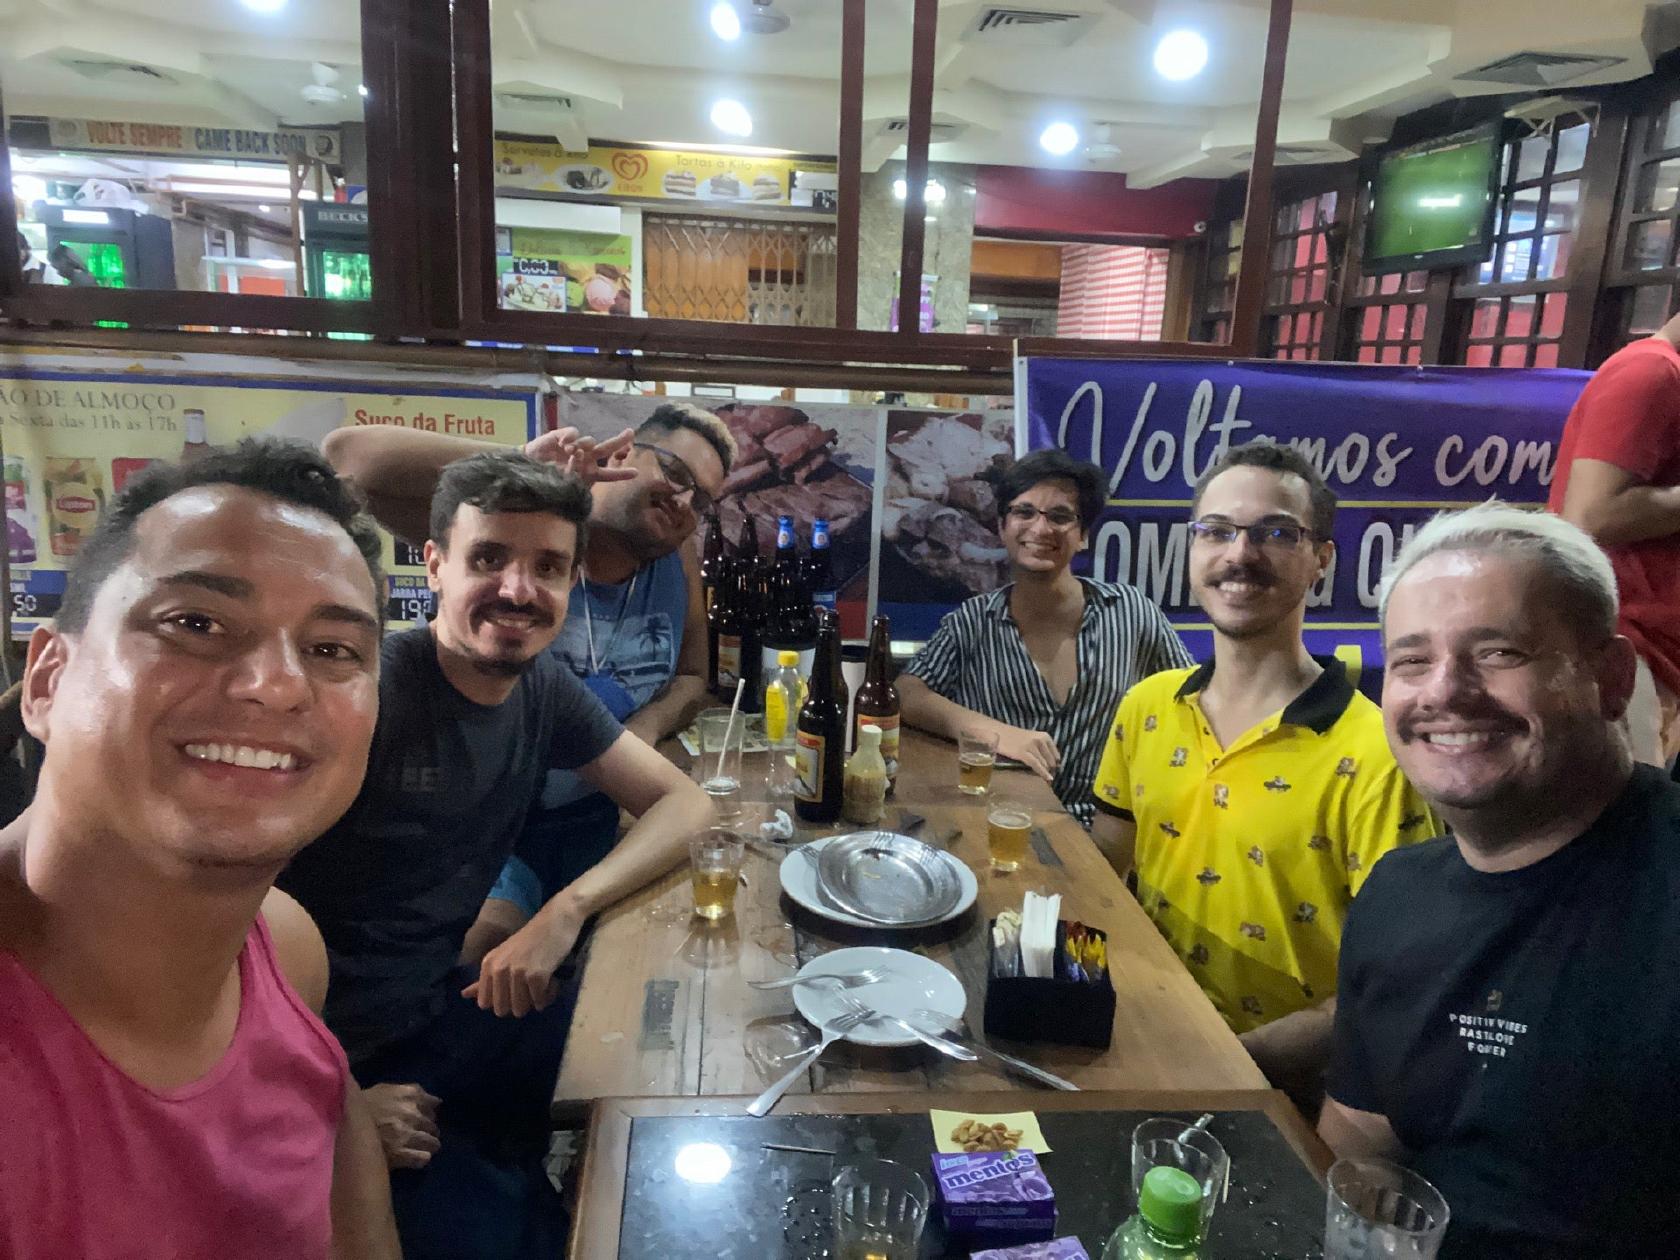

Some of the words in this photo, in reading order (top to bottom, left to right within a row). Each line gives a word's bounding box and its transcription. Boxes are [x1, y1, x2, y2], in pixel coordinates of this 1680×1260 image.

[86, 121, 127, 144] VOLTE
[129, 122, 183, 148] SEMPRE
[194, 127, 232, 151] CAME
[235, 129, 269, 153] BACK
[677, 154, 713, 168] Tortas
[36, 389, 66, 408] DE
[75, 391, 176, 414] ALMOÇO
[92, 414, 120, 430] 11h
[150, 415, 177, 432] 17h
[413, 412, 436, 432] da
[444, 414, 495, 436] Fruta
[1434, 433, 1556, 487] com
[943, 1152, 1035, 1188] mentos
